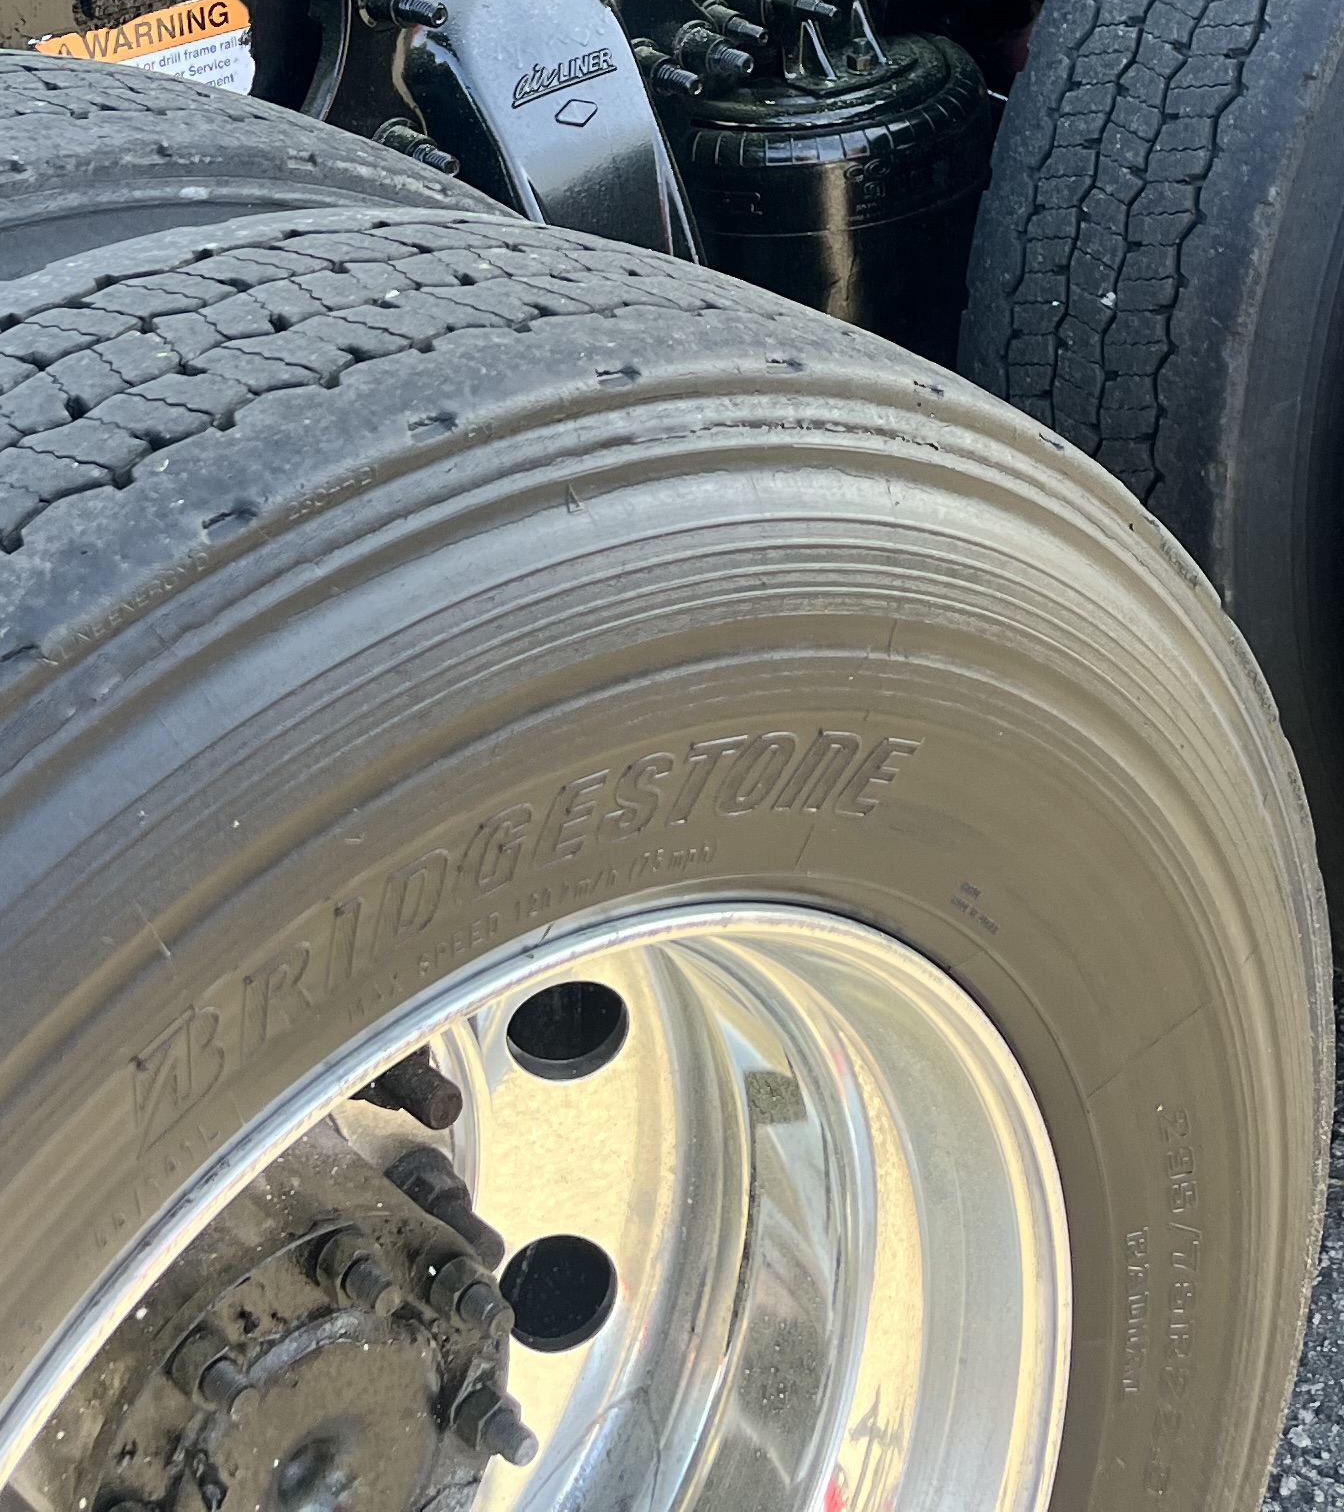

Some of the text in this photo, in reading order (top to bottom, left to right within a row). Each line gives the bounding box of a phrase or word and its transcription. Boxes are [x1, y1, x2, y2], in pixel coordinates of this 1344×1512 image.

[84, 1, 230, 59] WARNING
[159, 52, 181, 68] drill
[184, 44, 217, 61] frame
[188, 58, 231, 77] Service
[128, 728, 926, 1162] BRIDGESTONE
[418, 911, 500, 977] SPEED
